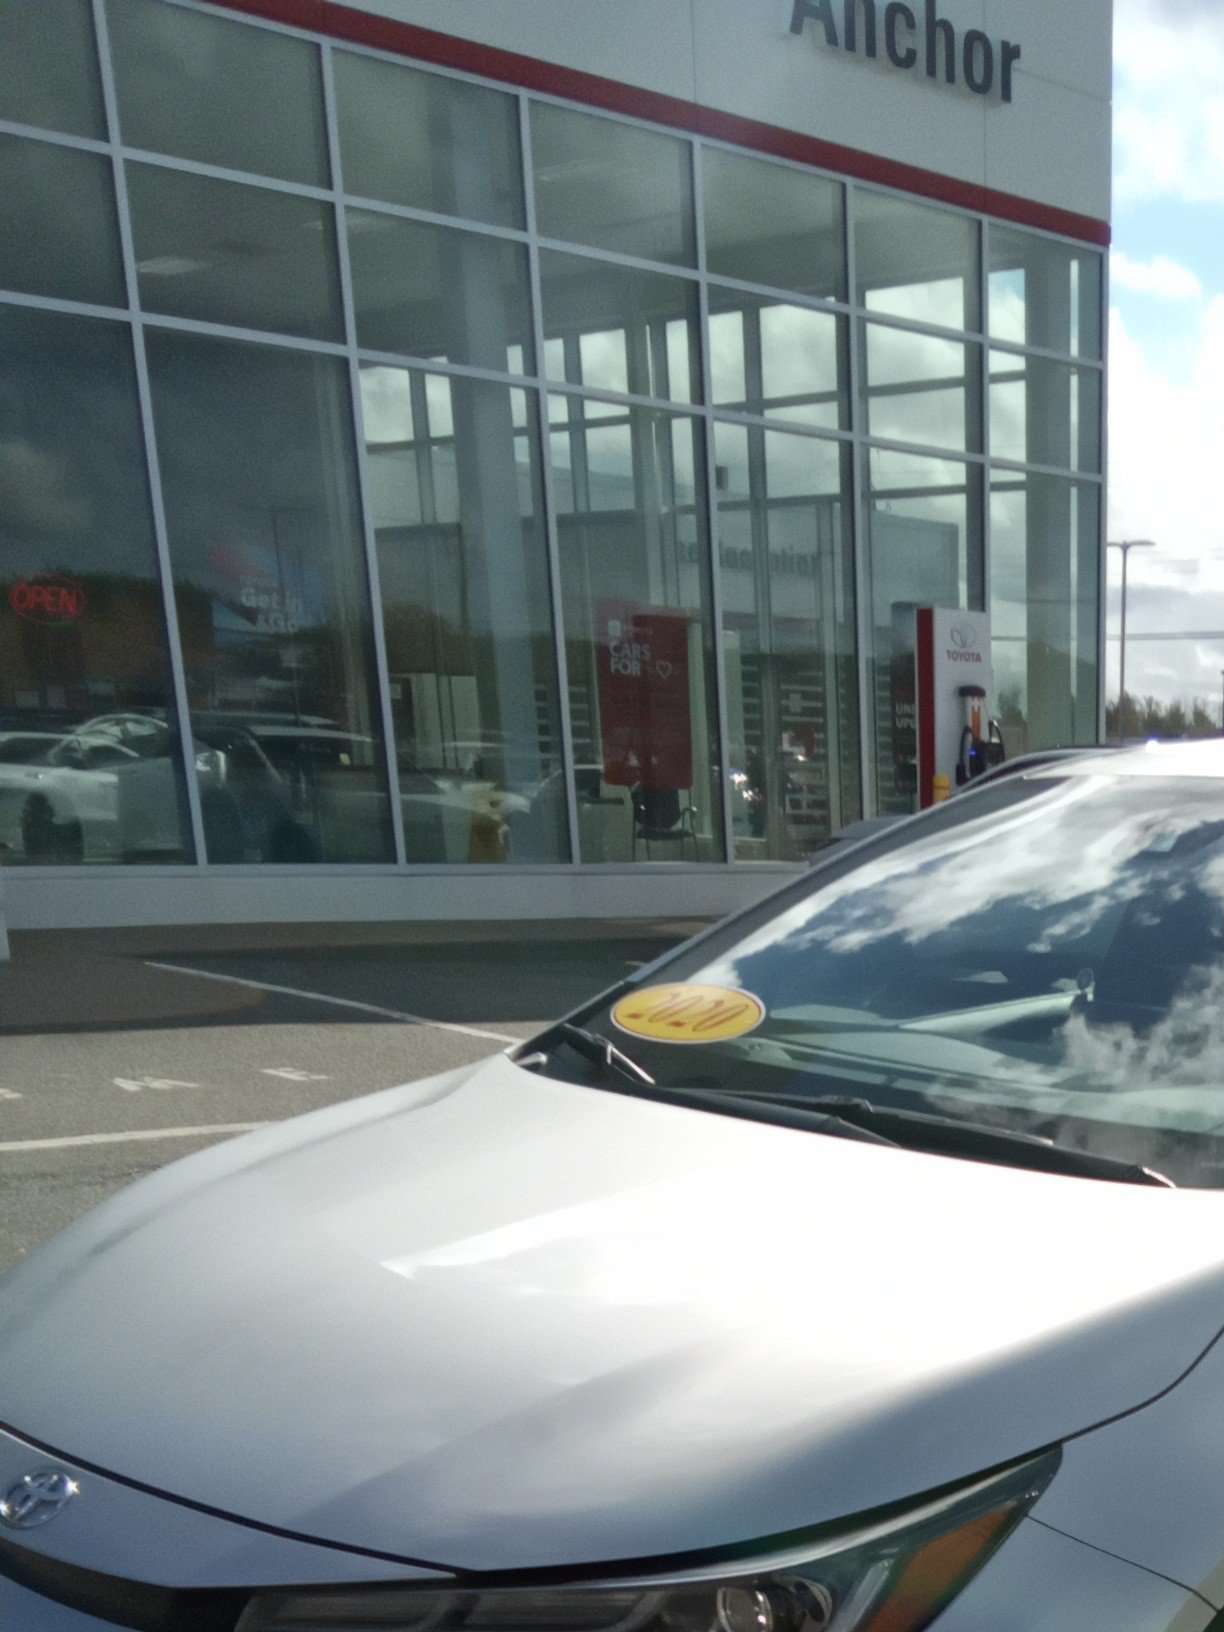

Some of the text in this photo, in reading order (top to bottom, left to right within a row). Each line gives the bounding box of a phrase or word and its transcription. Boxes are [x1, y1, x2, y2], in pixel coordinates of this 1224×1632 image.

[790, 0, 1021, 104] Anchor
[11, 584, 78, 616] OPEN
[608, 640, 651, 660] CARS
[946, 649, 982, 663] TOYOTA
[610, 656, 641, 676] FOR
